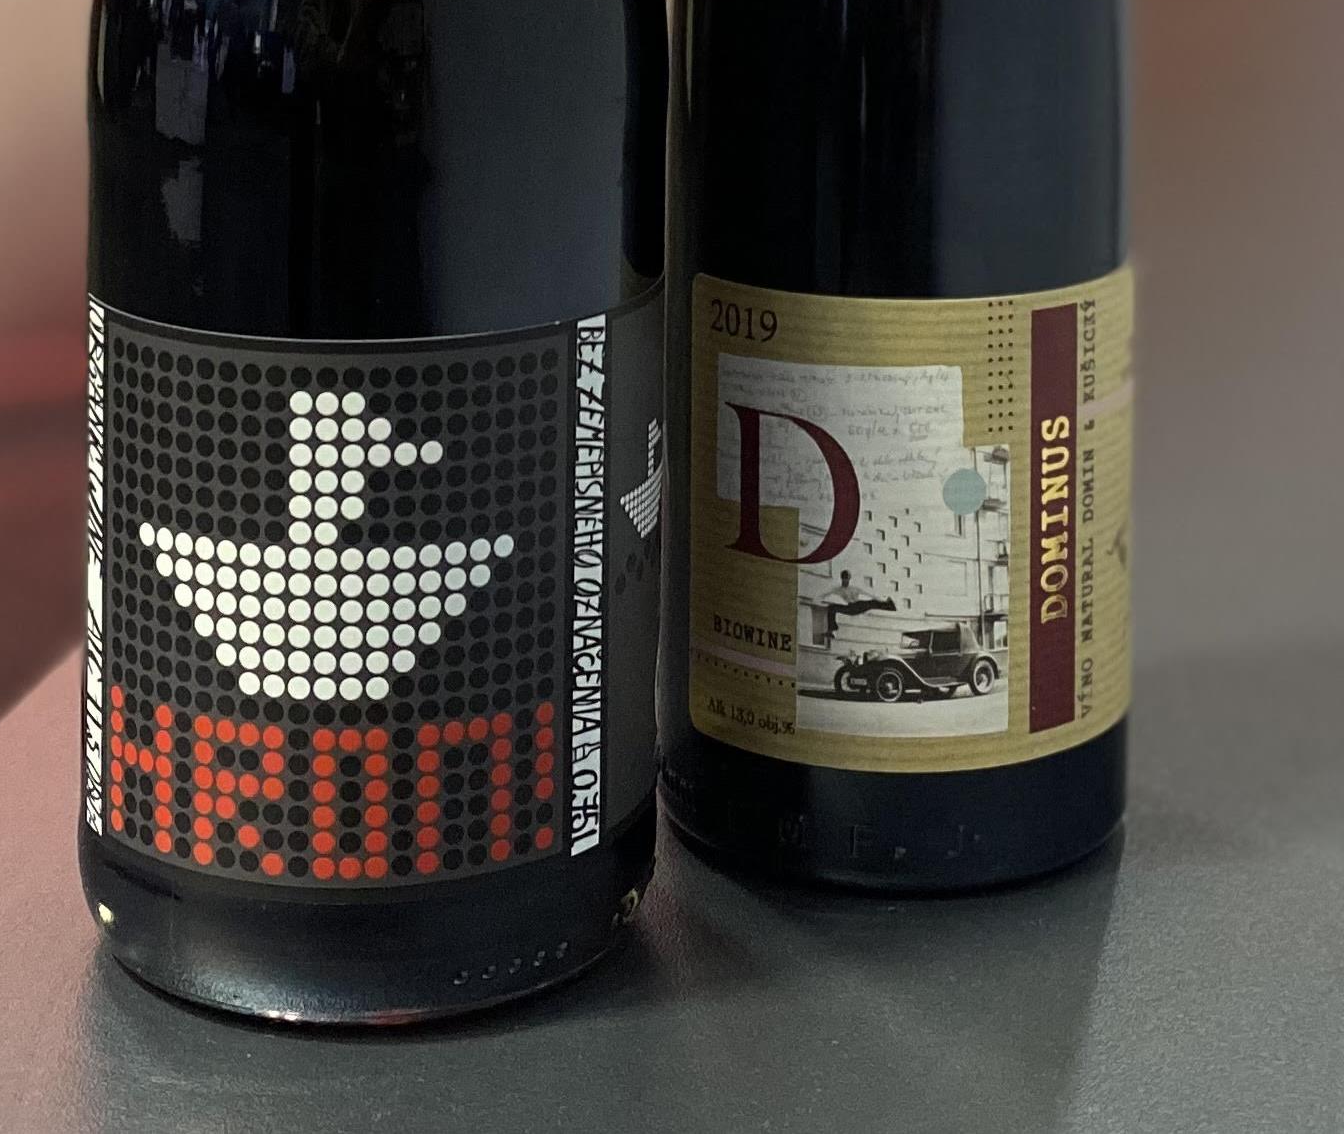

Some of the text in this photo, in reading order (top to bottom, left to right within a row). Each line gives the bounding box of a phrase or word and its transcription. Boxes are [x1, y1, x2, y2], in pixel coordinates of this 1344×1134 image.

[577, 326, 605, 379] BEZ
[710, 299, 779, 342] 2019
[87, 468, 105, 580] WINE
[724, 401, 861, 565] D
[1041, 415, 1070, 624] DOMINUS
[1077, 299, 1096, 719] VÍNO NATURAL DOMIN & KUŠICKÝ
[713, 615, 792, 652] BIOWINE
